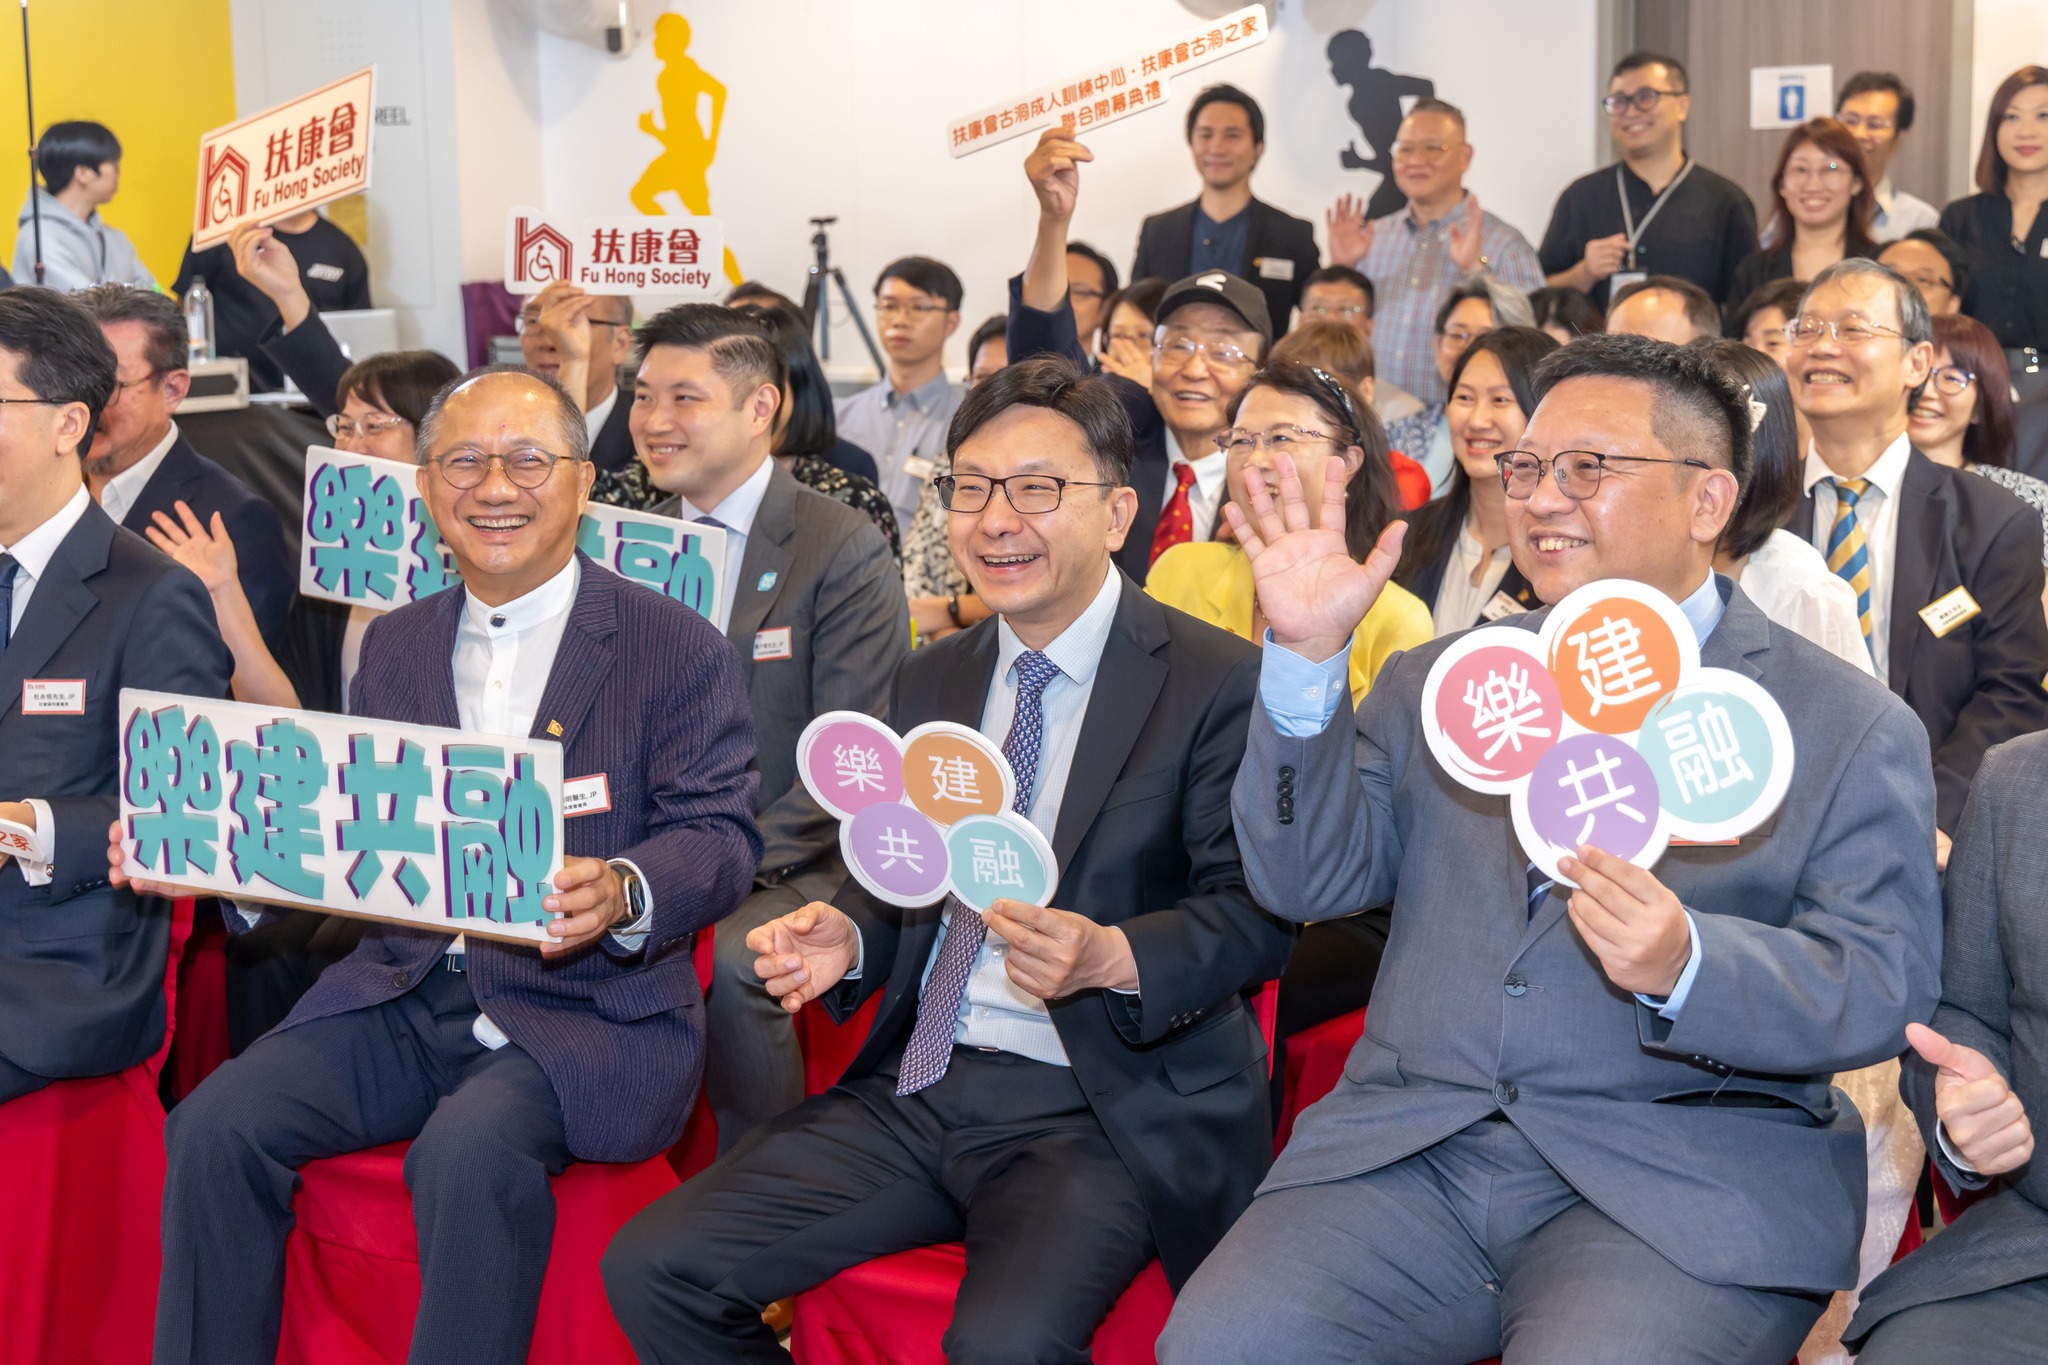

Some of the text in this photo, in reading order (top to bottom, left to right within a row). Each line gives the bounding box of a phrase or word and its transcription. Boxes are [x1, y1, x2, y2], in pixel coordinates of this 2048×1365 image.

[264, 101, 358, 182] 扶康會
[253, 154, 365, 212] Fu Hong Society
[591, 228, 701, 265] 扶康會
[581, 268, 711, 289] Fu Hong Society
[1462, 616, 1661, 761] 樂 建
[833, 744, 983, 804] 樂 建
[1558, 700, 1754, 846] 共 融
[124, 705, 554, 927] 樂建共融
[876, 827, 1024, 888] 共 融
